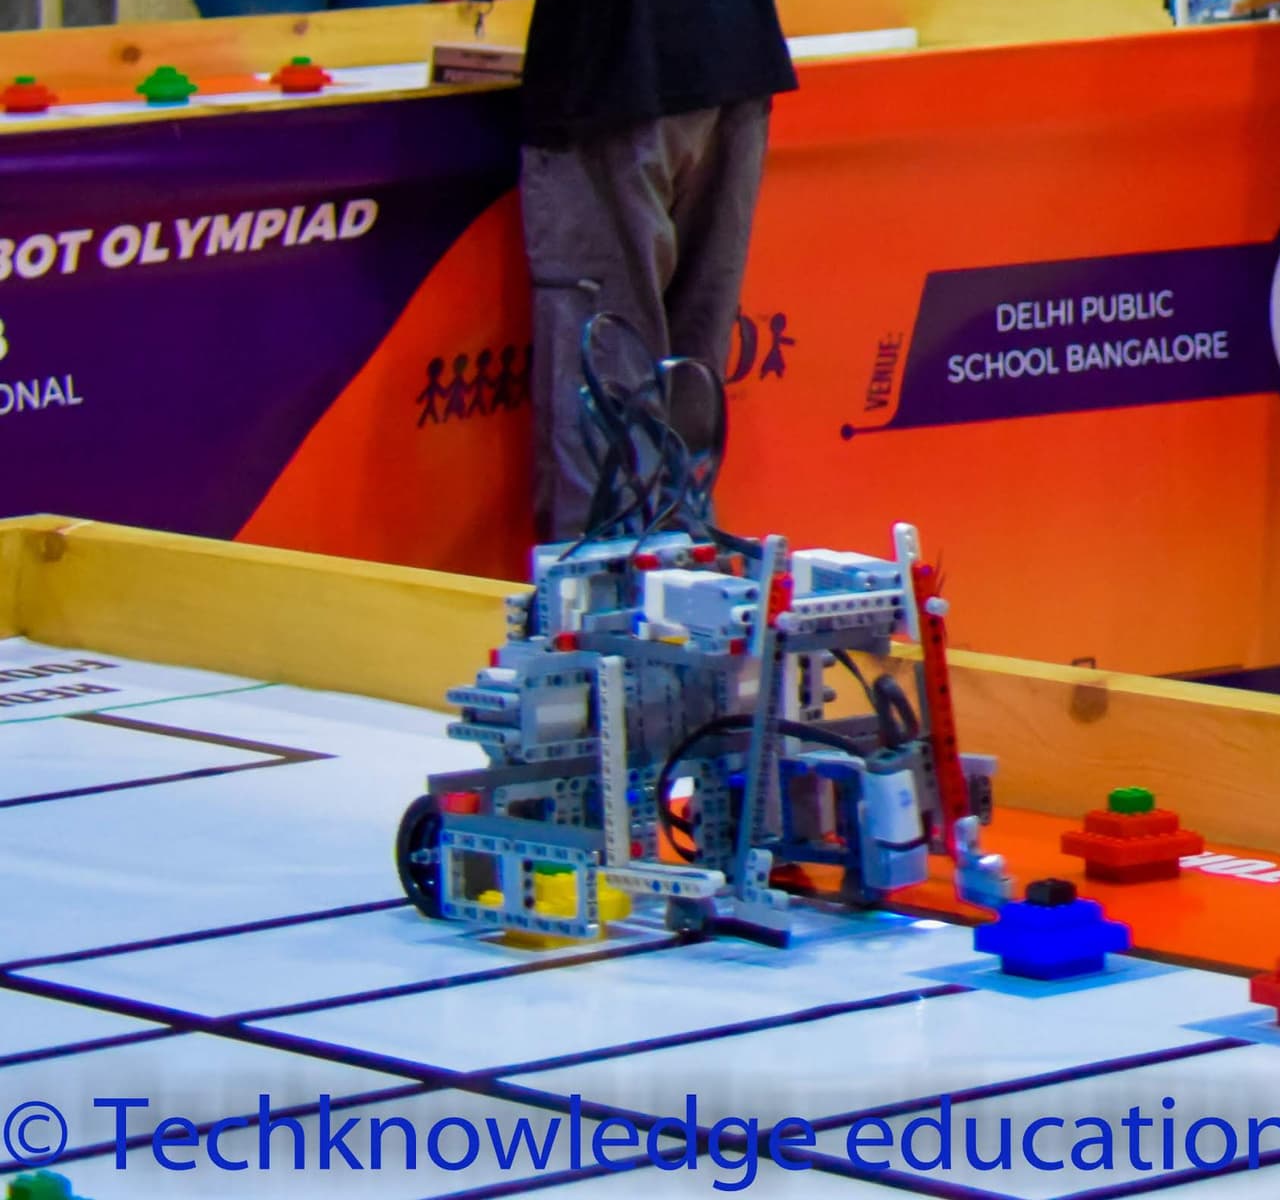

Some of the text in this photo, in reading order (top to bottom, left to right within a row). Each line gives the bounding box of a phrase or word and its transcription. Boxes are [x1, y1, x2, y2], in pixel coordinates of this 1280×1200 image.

[100, 199, 378, 268] OLYMPIAD
[996, 290, 1174, 333] DELHI PUBLIC
[947, 331, 1228, 383] SCHOOL BANGALORE
